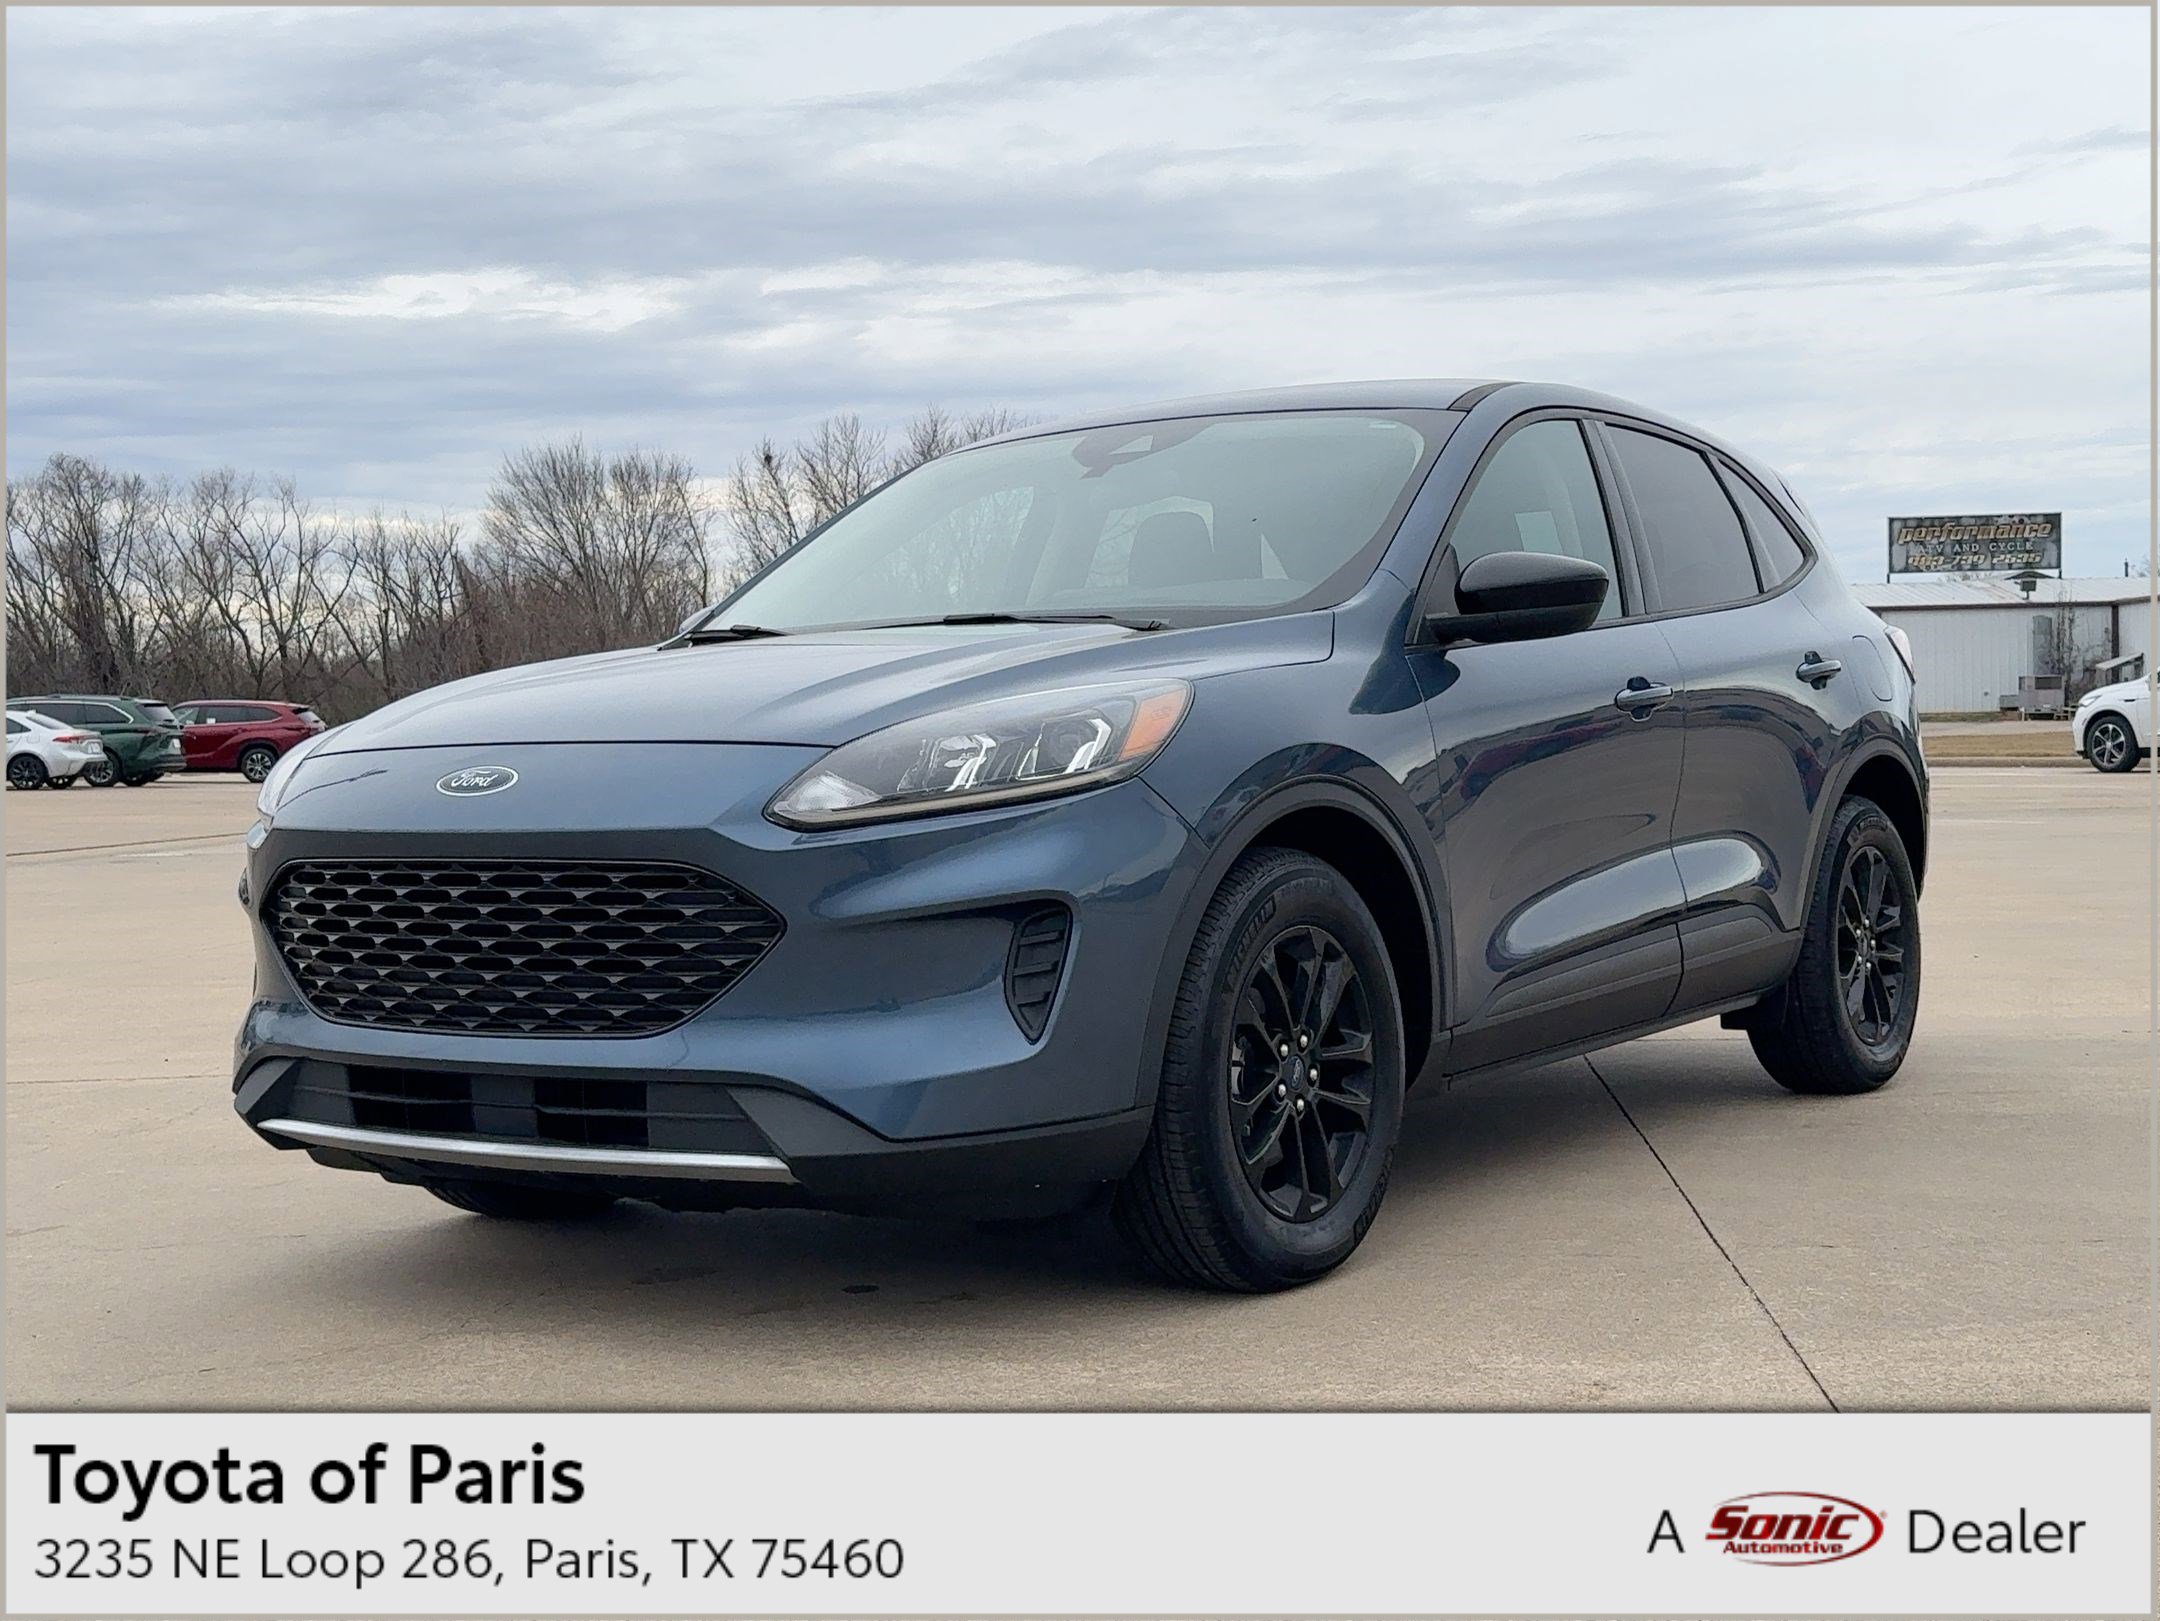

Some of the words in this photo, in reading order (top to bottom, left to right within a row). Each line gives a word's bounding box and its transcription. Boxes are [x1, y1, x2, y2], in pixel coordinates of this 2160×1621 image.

[1898, 522, 2053, 545] performance
[1918, 545, 1944, 554] ATV
[1953, 543, 1980, 553] AND
[1989, 542, 2034, 552] CYCLE
[451, 769, 498, 787] Ford
